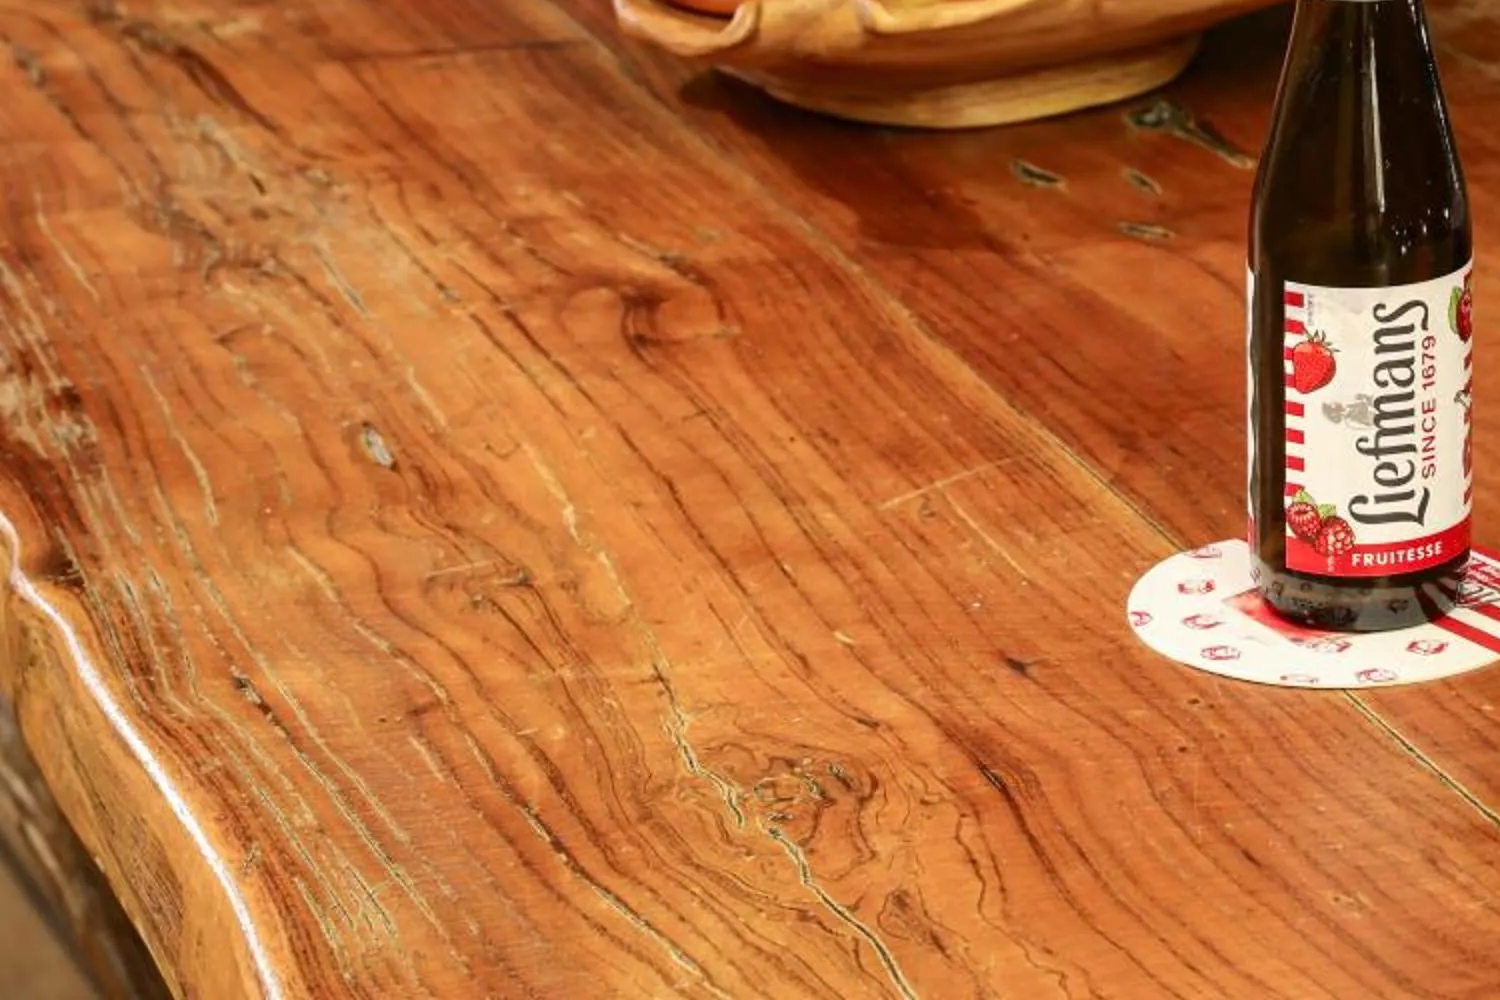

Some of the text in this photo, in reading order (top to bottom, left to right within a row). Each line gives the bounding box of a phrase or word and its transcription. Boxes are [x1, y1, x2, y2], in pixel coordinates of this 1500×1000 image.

[1347, 299, 1430, 527] Liefmans
[1421, 335, 1436, 479] SINCE 1679
[1351, 541, 1443, 567] FRUITESSE
